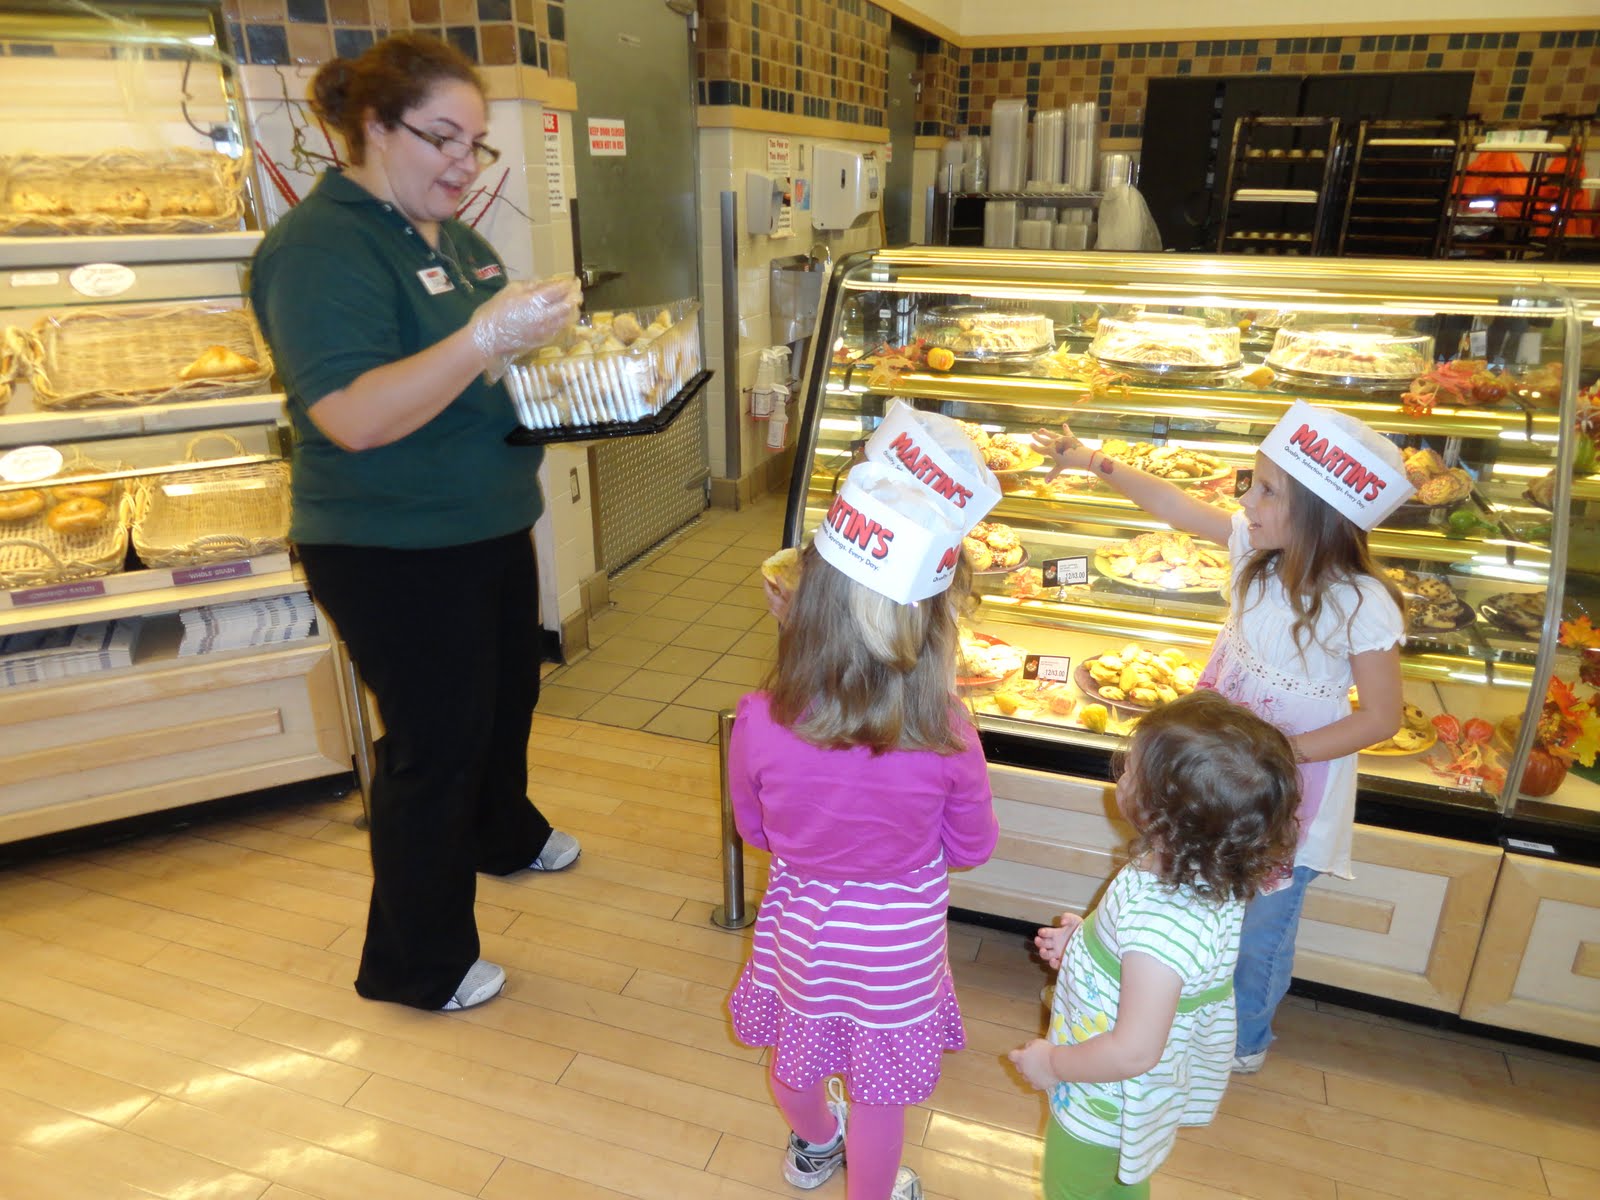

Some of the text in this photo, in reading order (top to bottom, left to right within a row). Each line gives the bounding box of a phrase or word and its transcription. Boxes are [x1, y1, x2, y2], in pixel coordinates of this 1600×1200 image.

[590, 127, 624, 137] KEEP DOOR CLOSED
[592, 140, 603, 149] WHEN
[612, 141, 616, 150] IN
[889, 431, 974, 508] MARTIN'S
[1290, 423, 1387, 501] MARTIN'S
[1301, 457, 1324, 478] Selection.
[1324, 475, 1344, 493] Savings.
[1344, 490, 1356, 503] Every
[827, 493, 894, 560] RTIN'S
[189, 567, 236, 580] WHOLE GRAIN
[848, 548, 864, 563] Every
[865, 558, 880, 572] Day.
